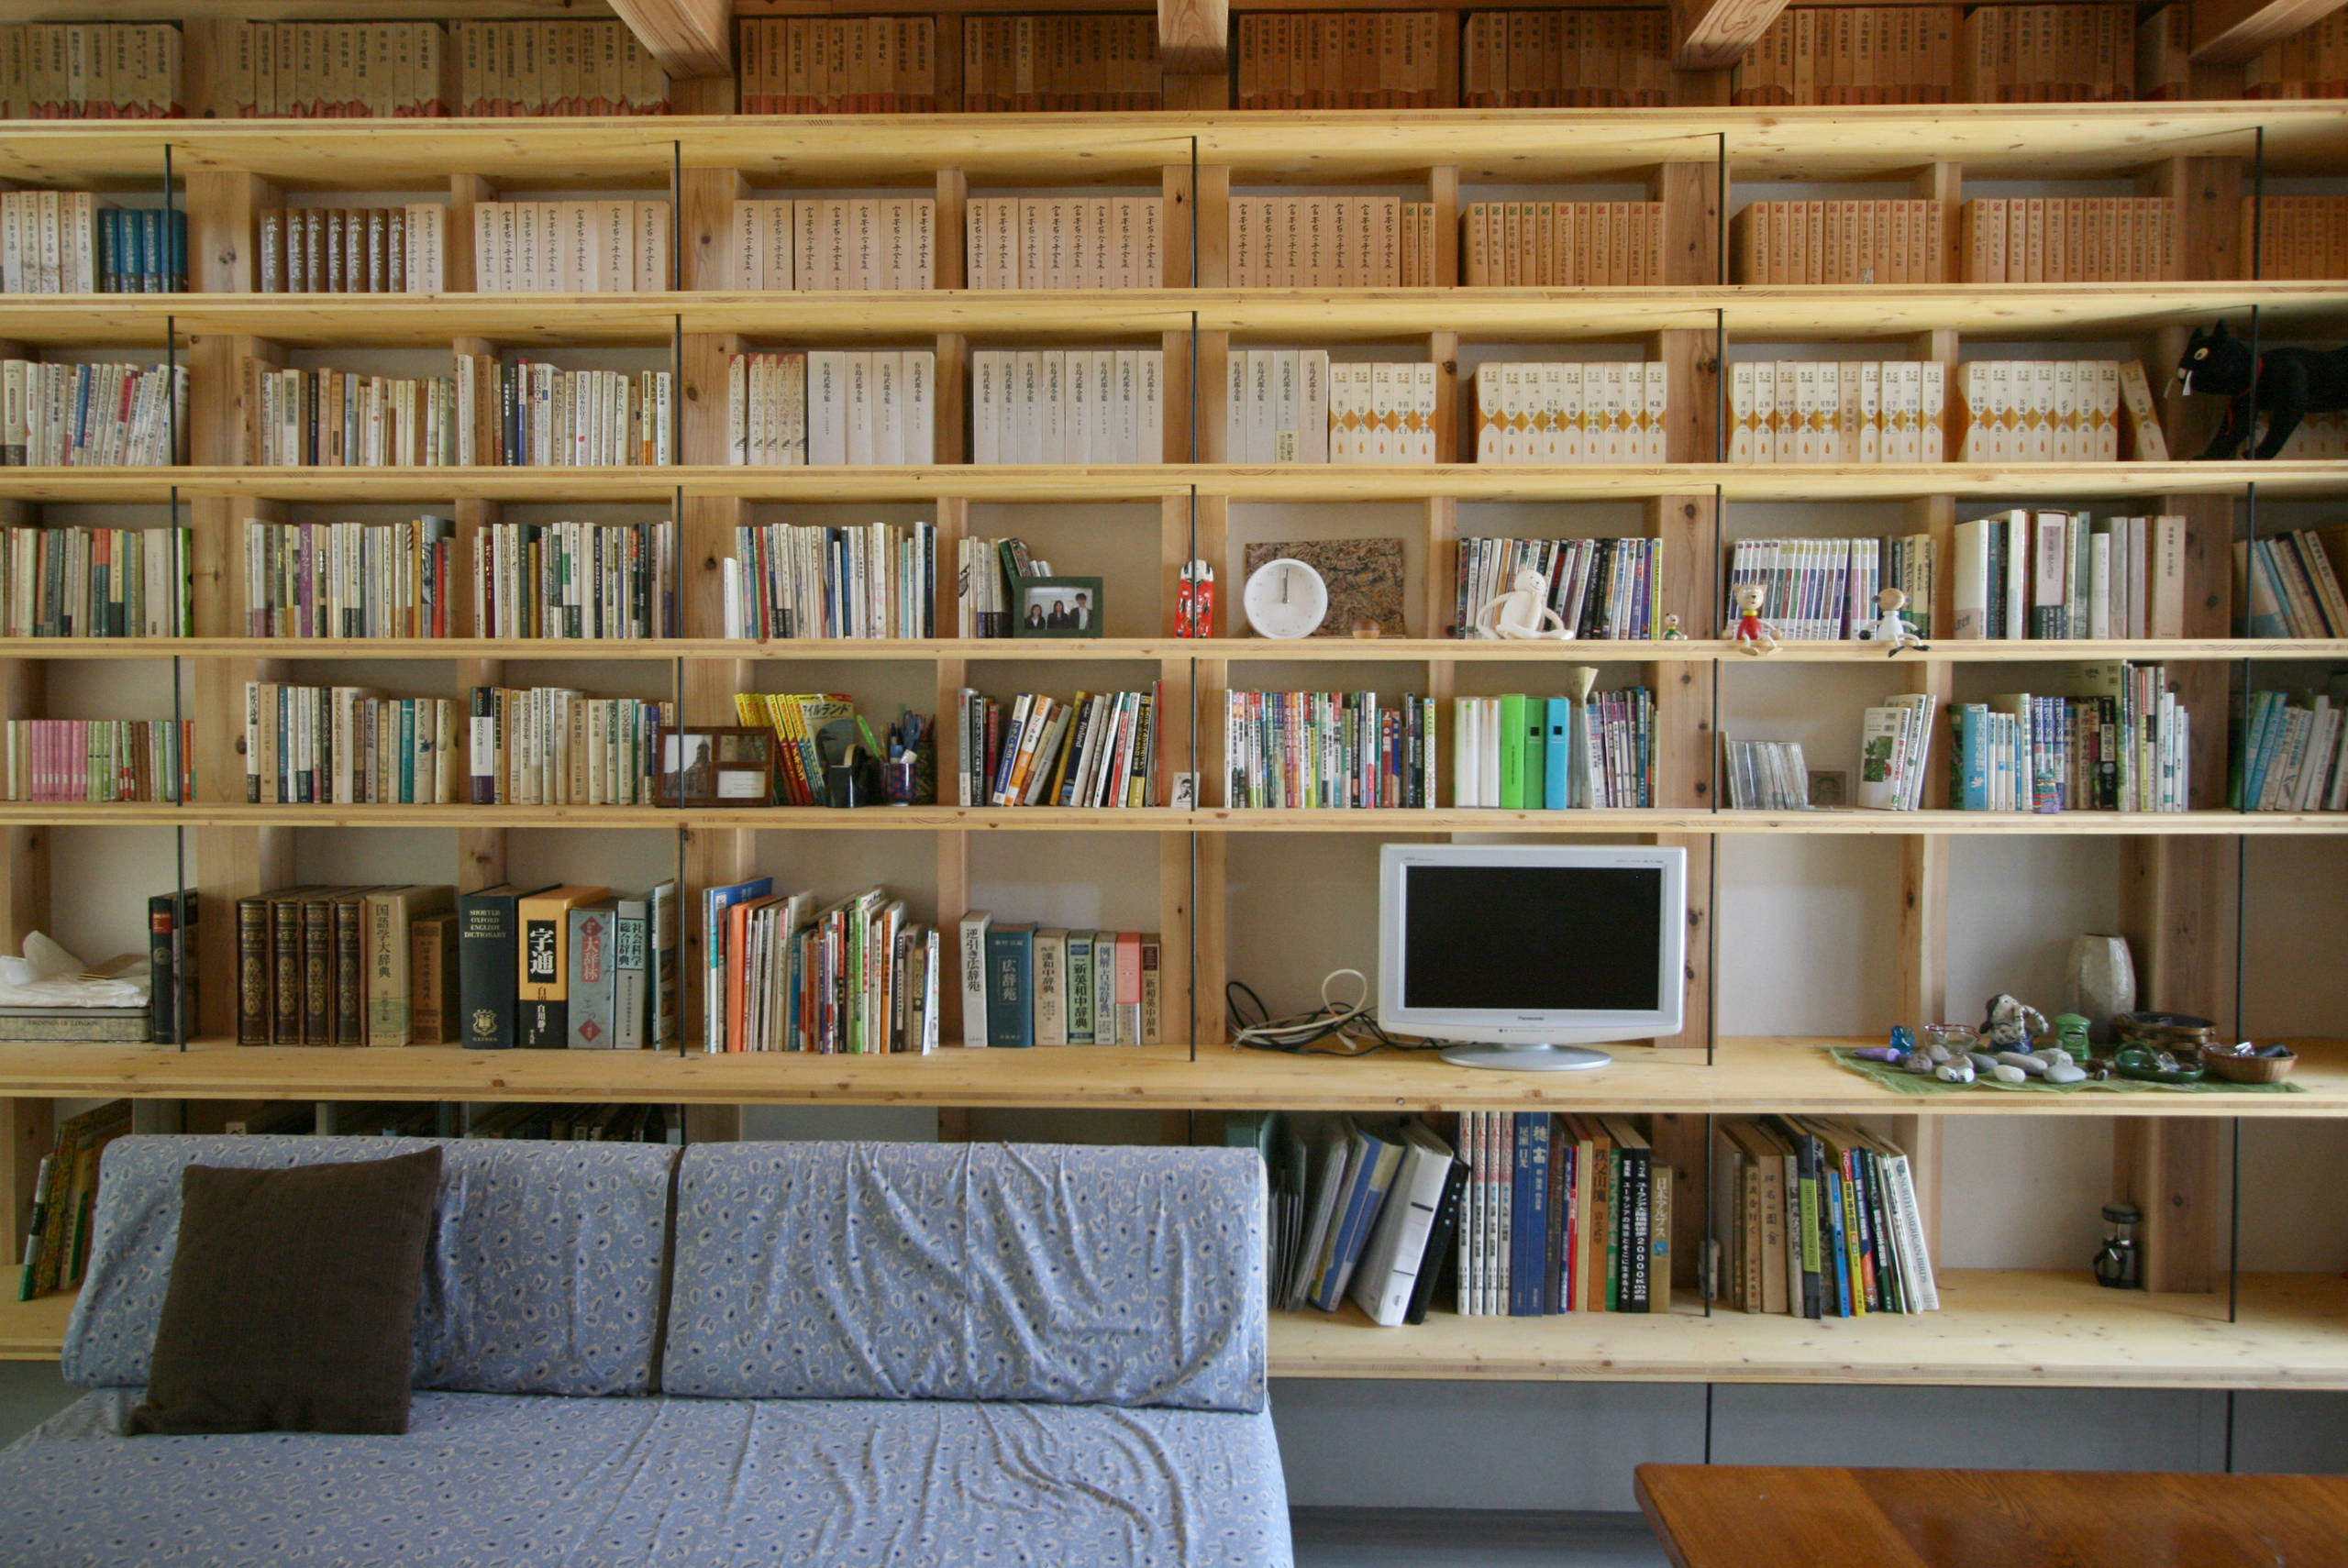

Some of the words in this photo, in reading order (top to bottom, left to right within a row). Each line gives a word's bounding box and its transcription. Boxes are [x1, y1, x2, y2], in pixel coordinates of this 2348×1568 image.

[376, 903, 392, 978] 国語学大辞典
[529, 928, 555, 976] 字通
[583, 937, 599, 980] 大辞林
[620, 922, 630, 966] 総合辞典
[632, 923, 643, 966] 社会科学
[966, 928, 981, 992] 逆引き広辞苑
[1002, 958, 1016, 1001] 広辞苑
[1042, 953, 1055, 993] 漢和中辞典
[1074, 963, 1087, 1028] 新英和中辞典
[1146, 979, 1155, 1036] 新和英中辞典
[1655, 1177, 1667, 1237] 日本アルプス
